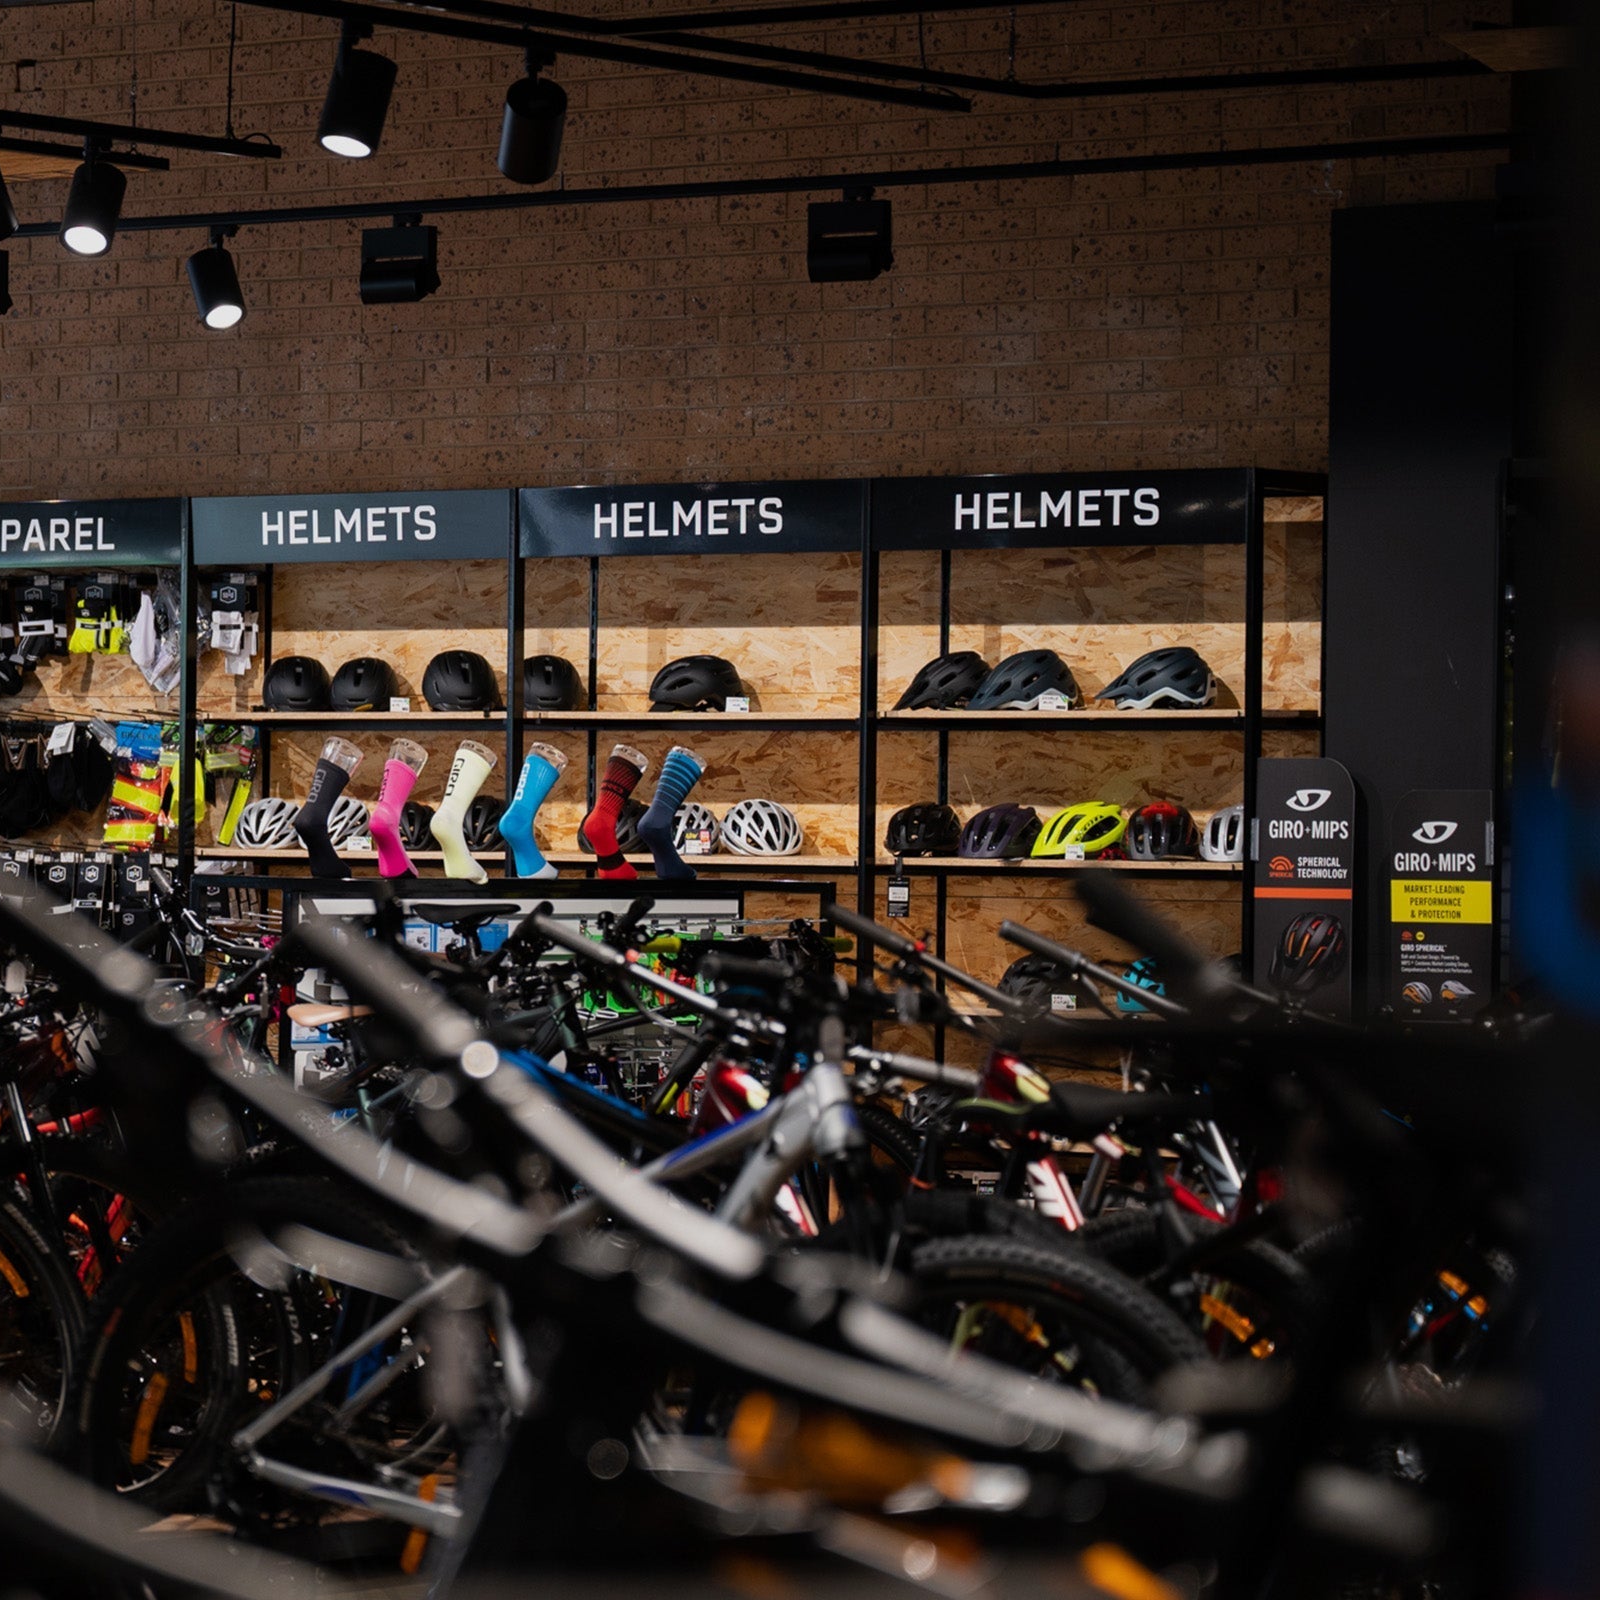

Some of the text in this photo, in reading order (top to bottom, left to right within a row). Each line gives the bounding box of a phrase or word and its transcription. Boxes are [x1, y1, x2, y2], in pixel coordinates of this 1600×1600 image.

[593, 497, 783, 539] HELMETS
[954, 487, 1160, 531] HELMETS
[261, 505, 437, 546] HELMETS
[307, 768, 327, 803] GIRO
[444, 758, 465, 796] GIRO
[514, 763, 530, 800] GIRO
[1268, 819, 1349, 840] GIRO+MIPS
[1297, 856, 1341, 868] SPHERICAL
[1394, 852, 1476, 873] GIRO+MIPS
[1297, 867, 1348, 879] TECHNOLOGY
[1403, 885, 1466, 895] MARKET-LEADING
[1409, 897, 1462, 907] PERFORMANCE
[1410, 909, 1462, 919] & PROTECTION
[1400, 943, 1415, 952] GIRO
